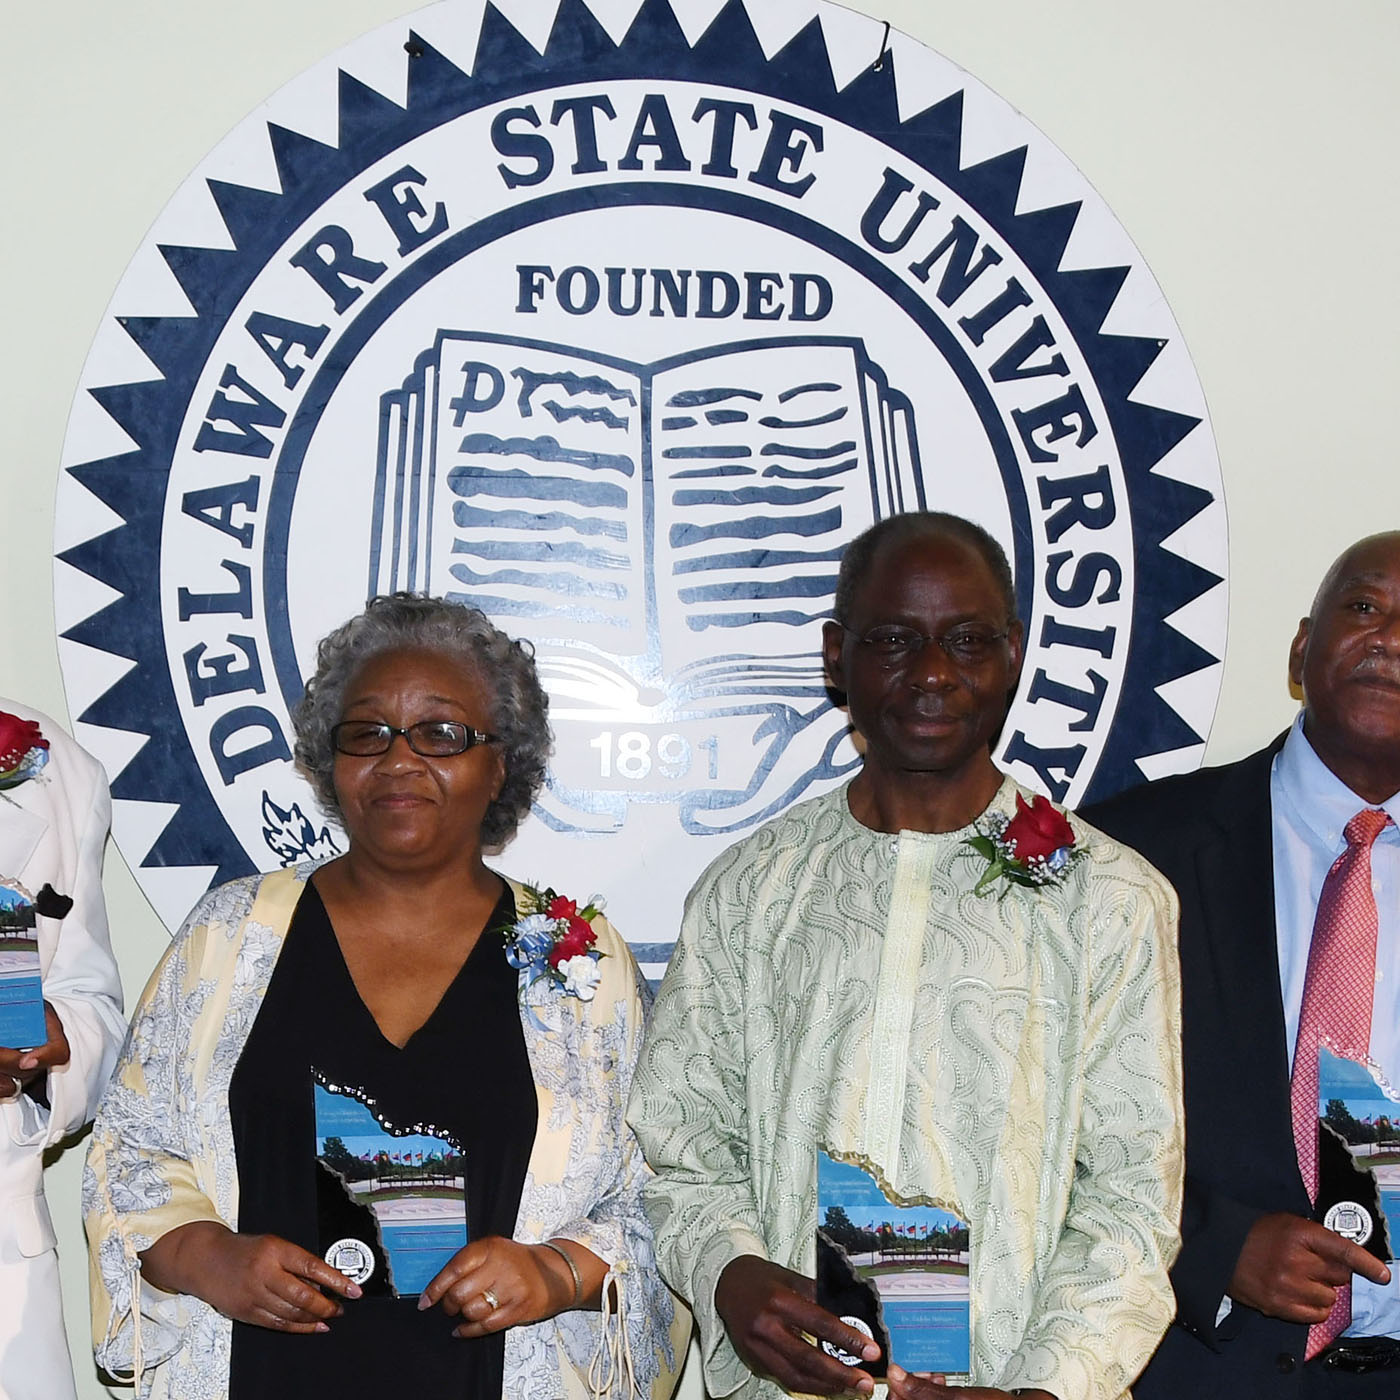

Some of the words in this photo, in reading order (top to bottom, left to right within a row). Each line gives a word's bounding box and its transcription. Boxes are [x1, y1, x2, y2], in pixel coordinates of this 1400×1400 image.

[515, 264, 833, 321] FOUNDED
[178, 164, 449, 787] DELAWARE
[490, 94, 824, 198] STATE
[860, 168, 1121, 805] UNIVERSITY
[589, 730, 719, 780] 1891
